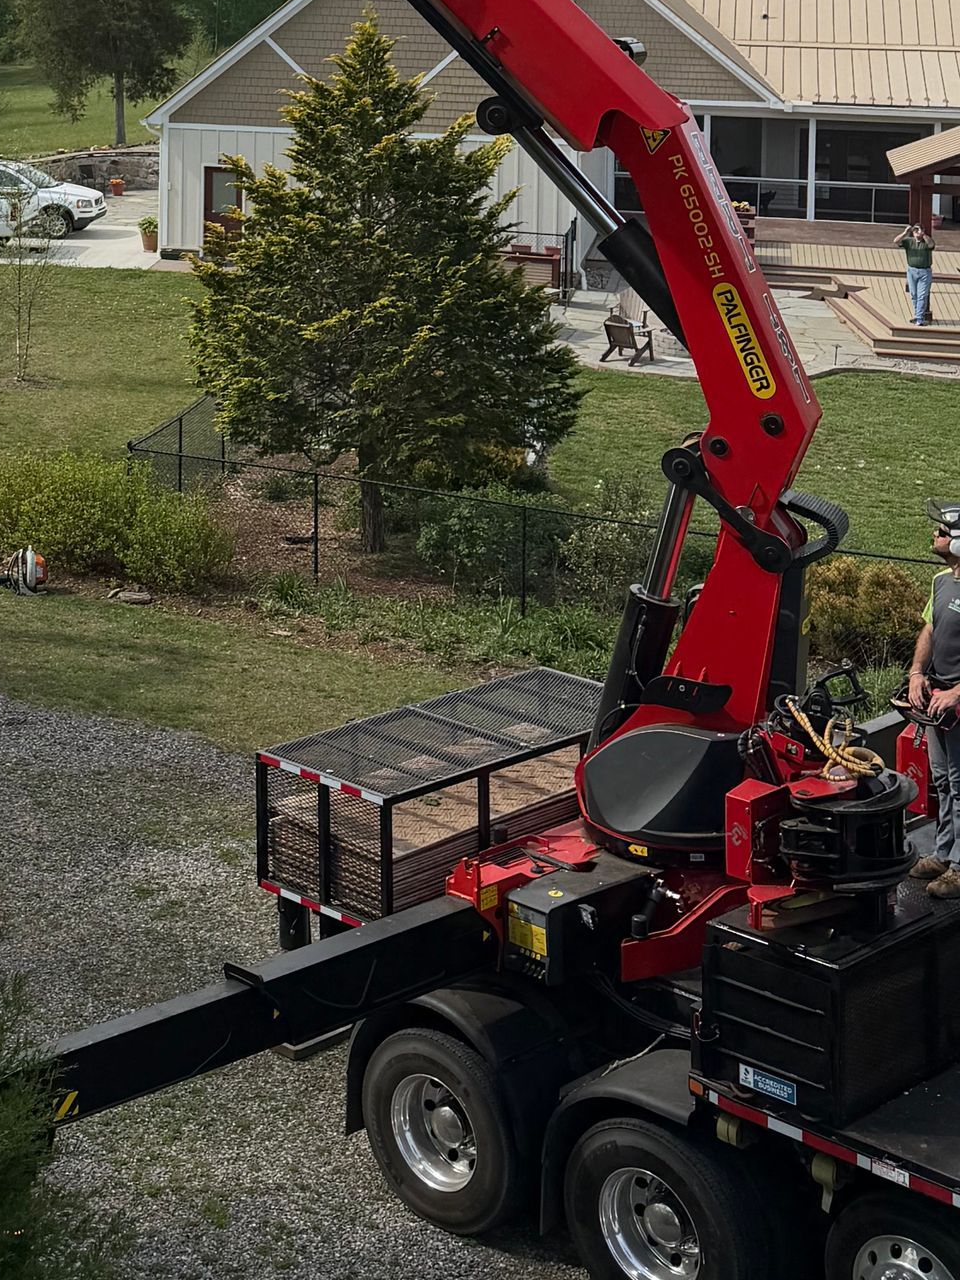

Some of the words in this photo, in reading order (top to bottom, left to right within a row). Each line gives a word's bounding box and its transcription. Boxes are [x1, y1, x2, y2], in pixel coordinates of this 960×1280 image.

[668, 154, 689, 180] PK
[716, 289, 771, 393] PALFINGER
[754, 1074, 793, 1094] ACCREDITED
[758, 1082, 788, 1098] BUSINESS
